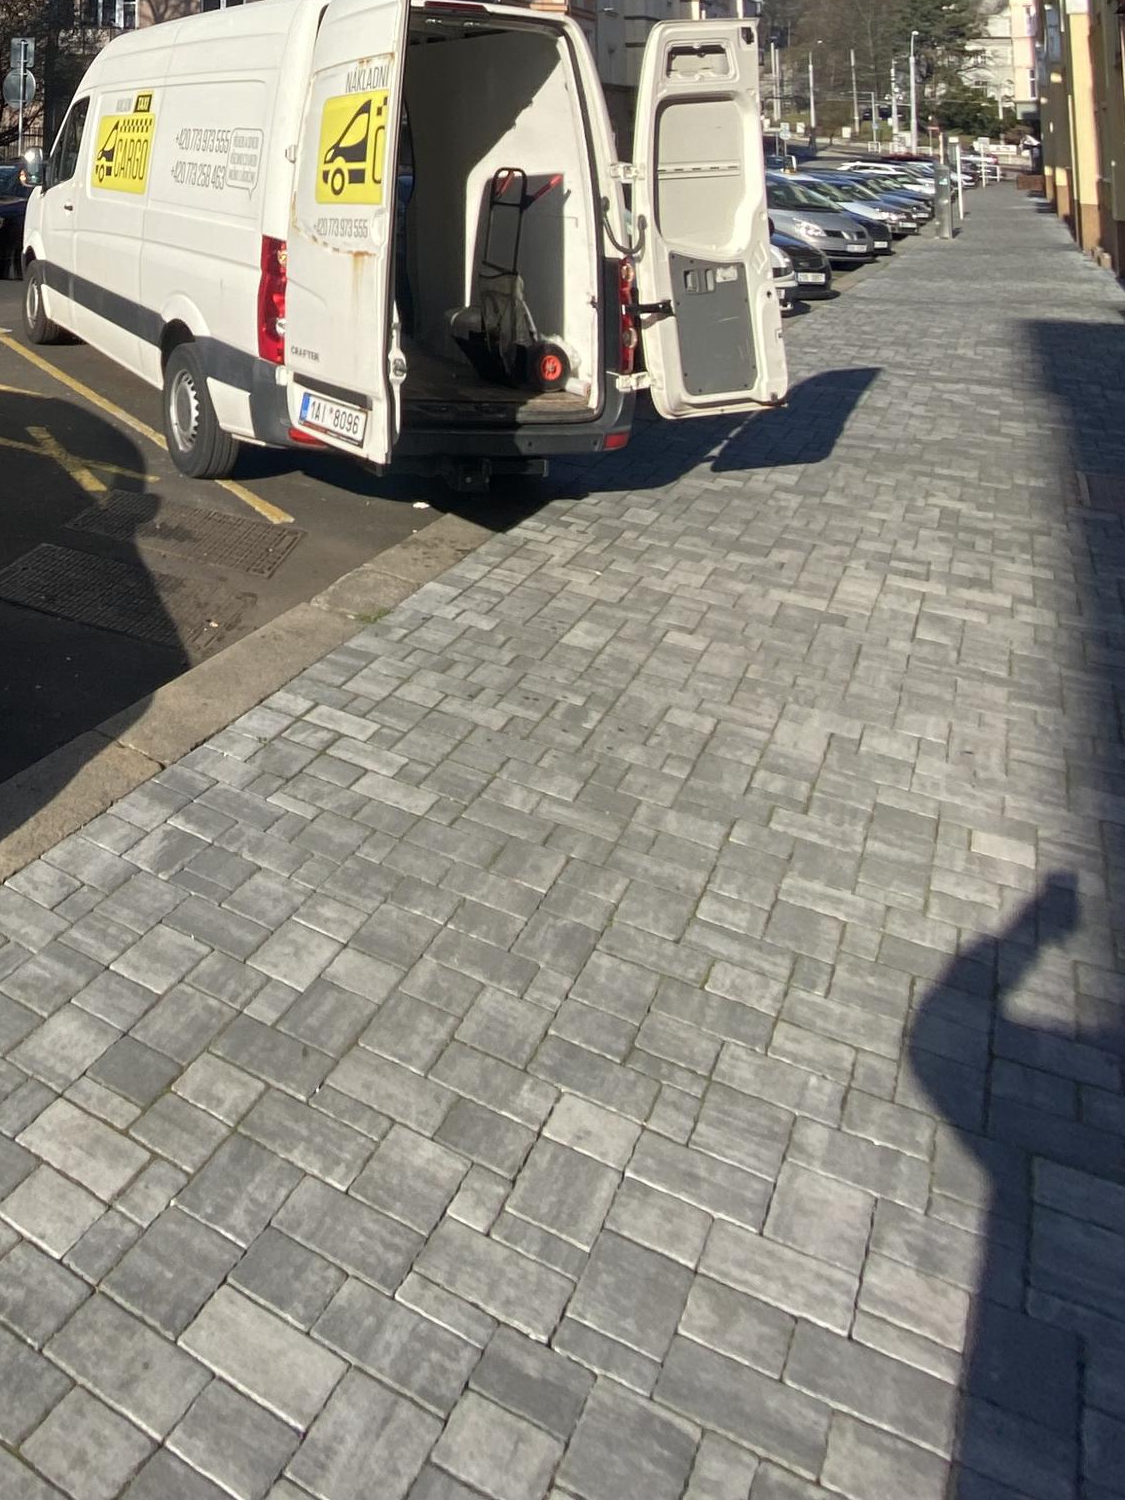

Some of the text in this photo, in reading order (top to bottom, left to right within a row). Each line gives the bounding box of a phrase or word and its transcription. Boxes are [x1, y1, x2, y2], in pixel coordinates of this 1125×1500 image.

[191, 128, 203, 151] 773
[202, 129, 216, 153] 973
[215, 130, 231, 154] 555
[114, 138, 148, 180] CARGO
[328, 218, 340, 237] 773
[340, 218, 353, 237] 973
[354, 219, 368, 238] 555
[291, 346, 320, 362] CRAFTER
[333, 409, 360, 435] 8096
